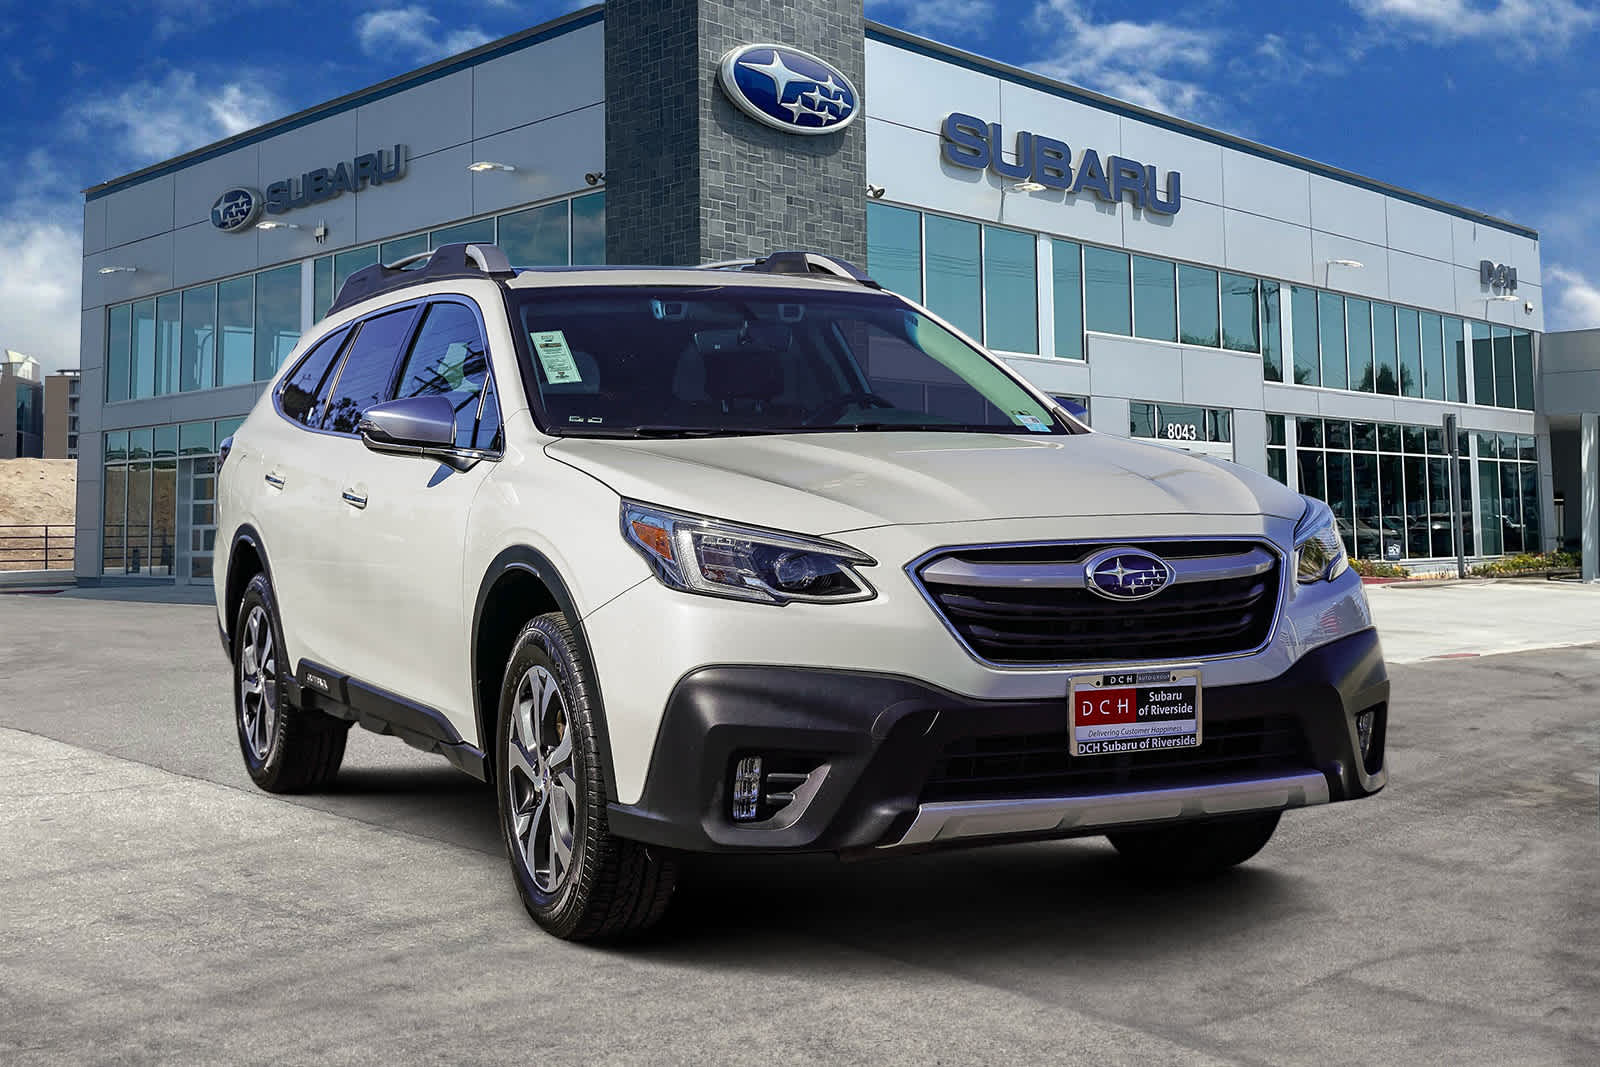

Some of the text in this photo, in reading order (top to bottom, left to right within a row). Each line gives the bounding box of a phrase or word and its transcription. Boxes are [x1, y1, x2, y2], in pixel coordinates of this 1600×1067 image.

[942, 112, 1181, 215] SUBARU
[265, 144, 407, 216] SUBARU
[1167, 423, 1196, 440] 8043
[1149, 691, 1182, 702] Subaru
[1138, 703, 1193, 716] of Riverside
[1088, 725, 1183, 738] Delivering Customer Happiness
[1078, 735, 1196, 754] DCH Subaru of Riverside
